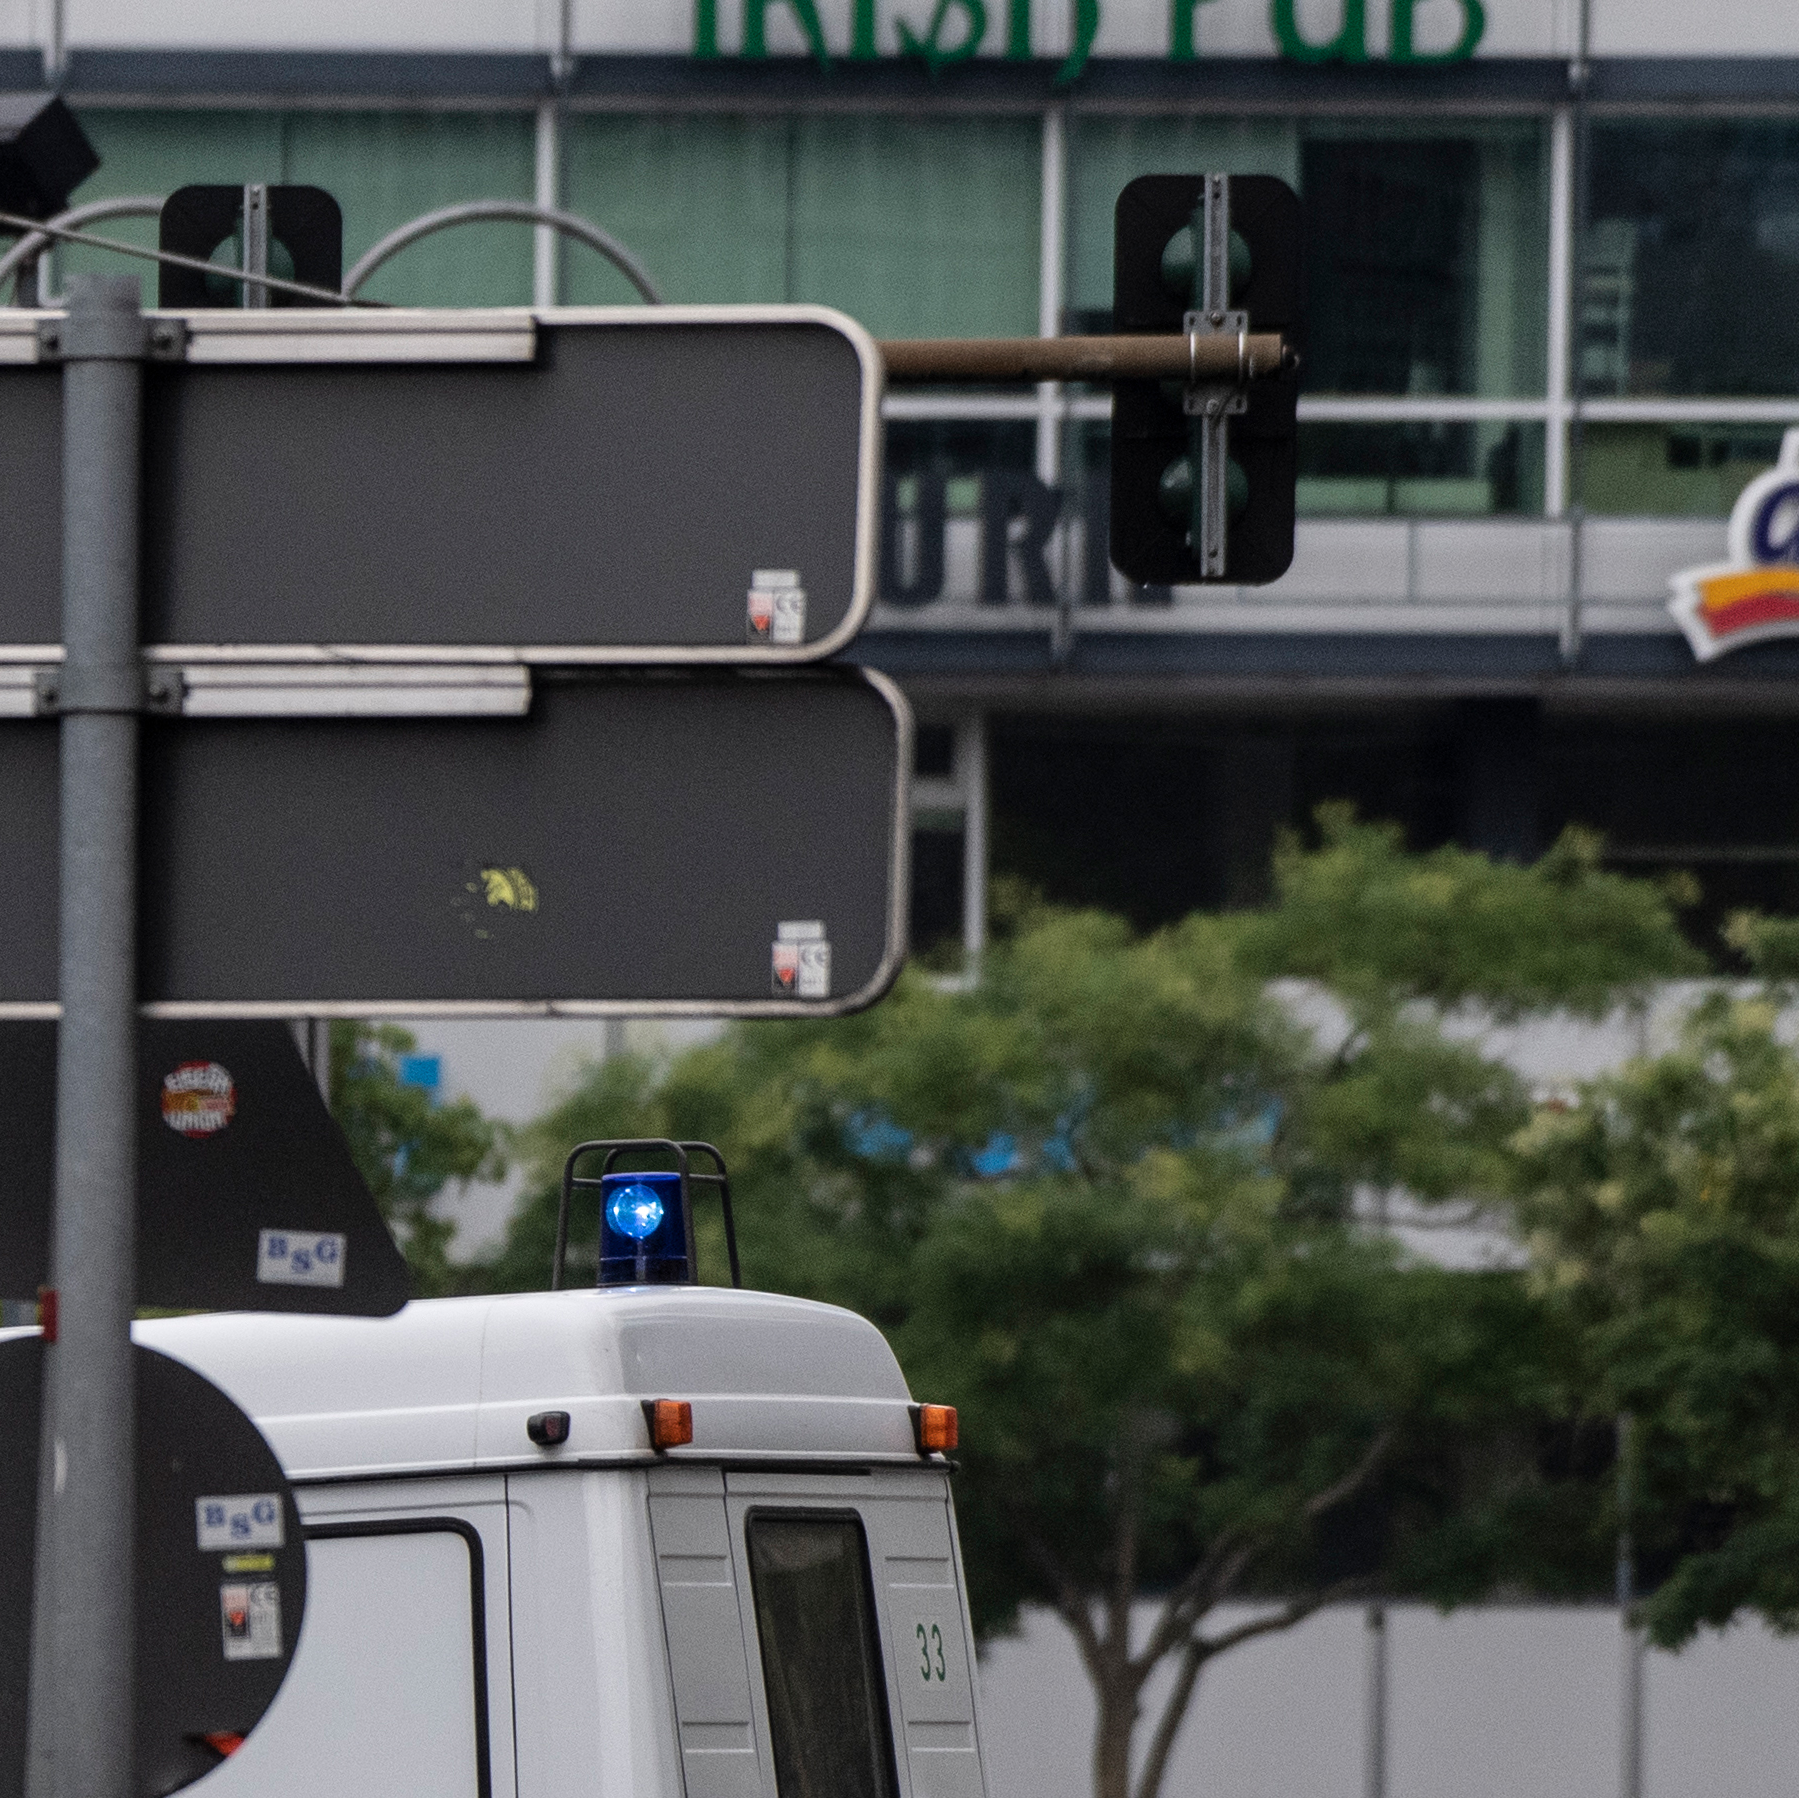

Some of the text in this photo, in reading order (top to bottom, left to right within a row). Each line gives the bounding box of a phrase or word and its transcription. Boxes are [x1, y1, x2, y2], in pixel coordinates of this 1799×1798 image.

[266, 1236, 340, 1273] BSG
[204, 1499, 278, 1540] BSG
[916, 1622, 946, 1683] 33
